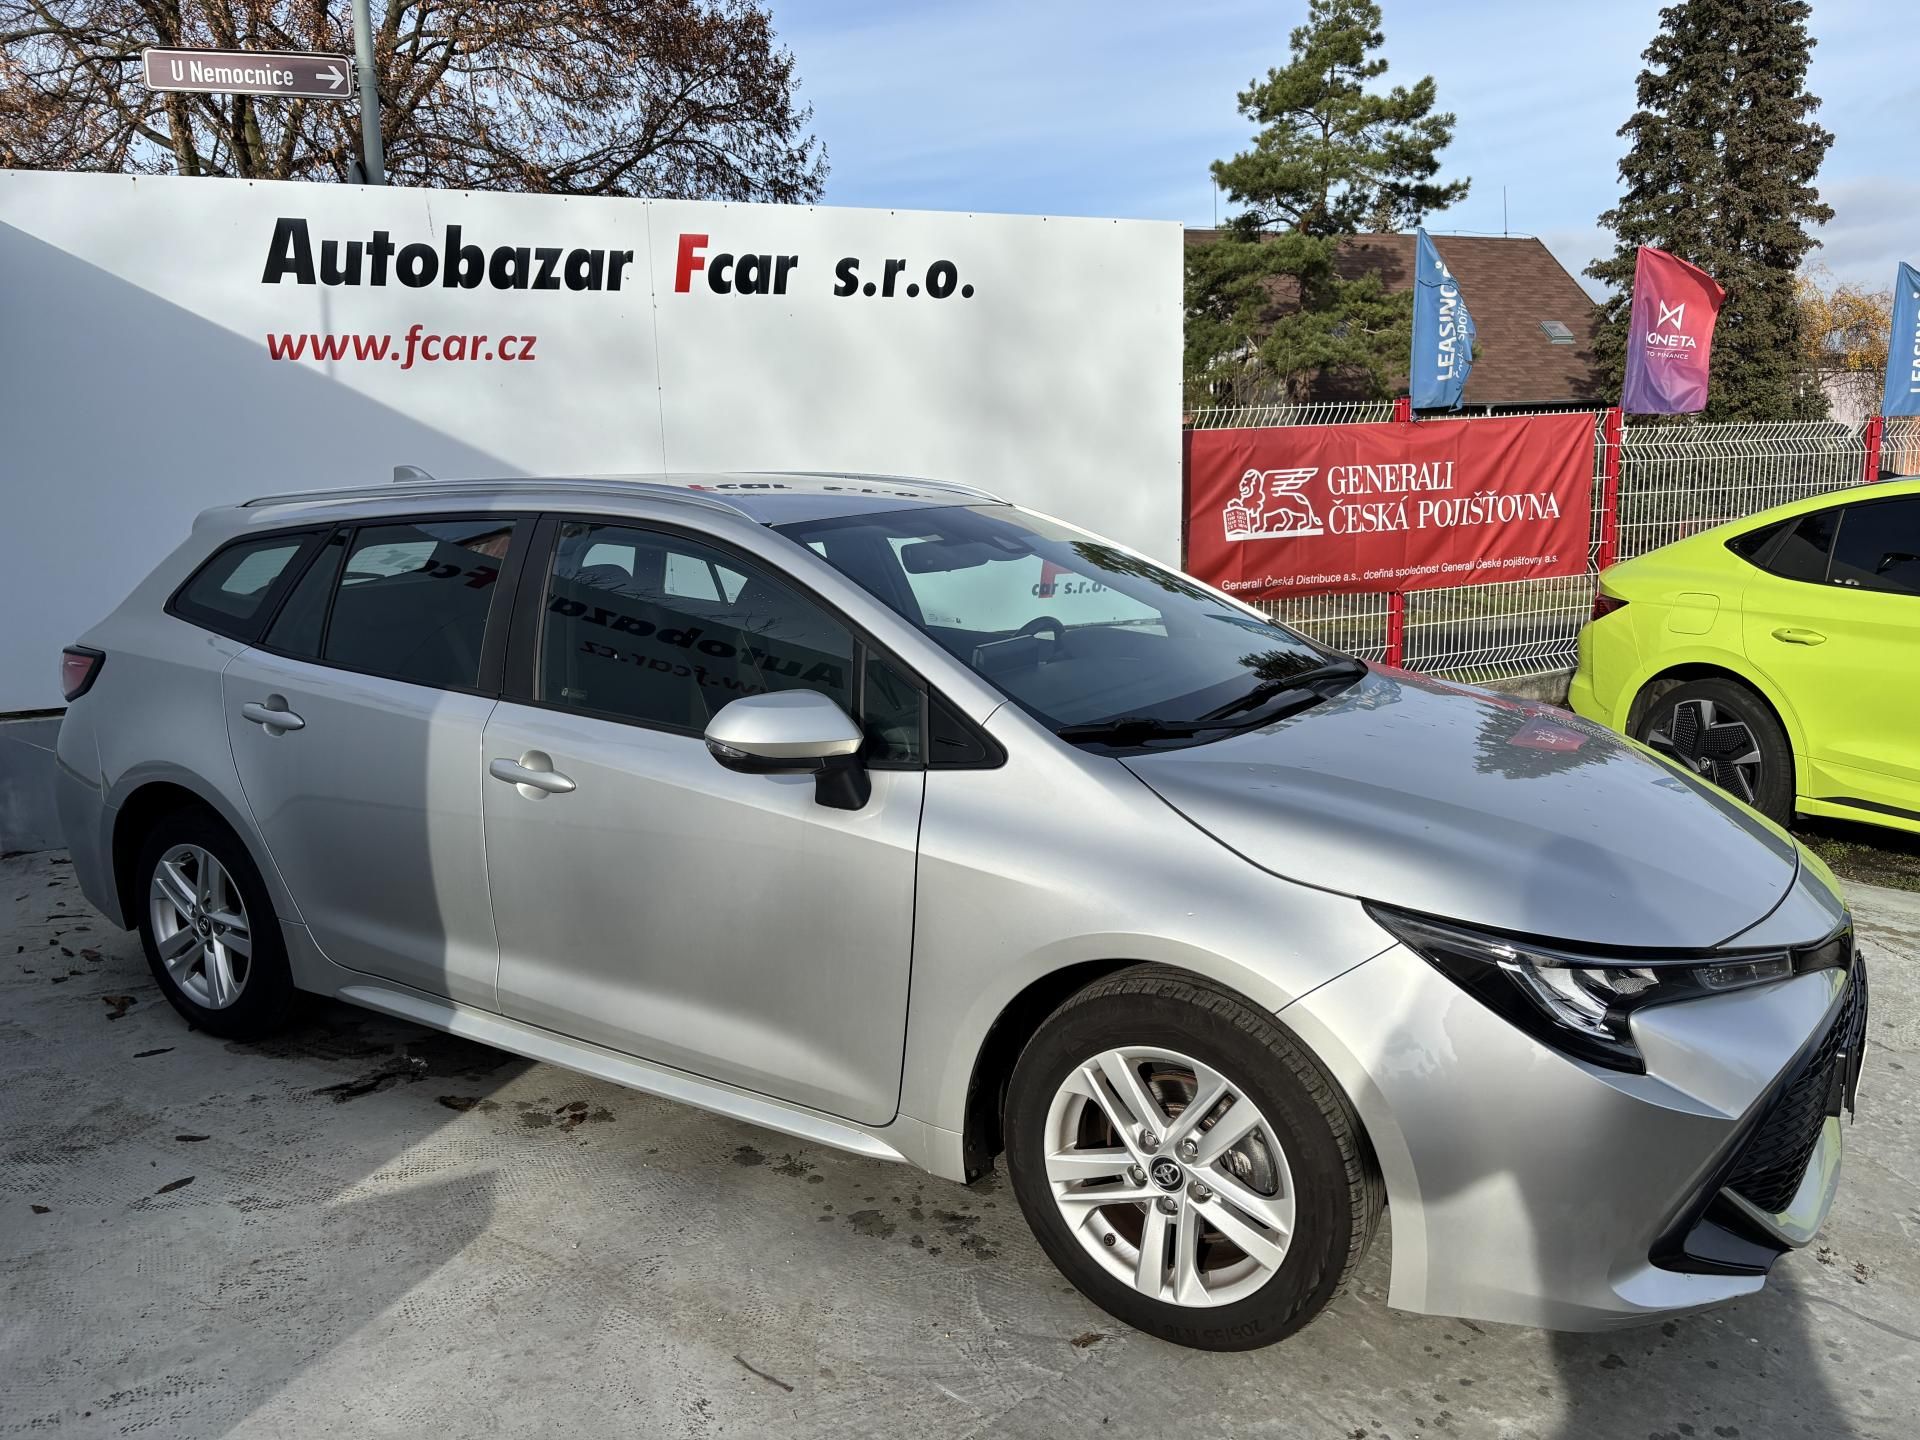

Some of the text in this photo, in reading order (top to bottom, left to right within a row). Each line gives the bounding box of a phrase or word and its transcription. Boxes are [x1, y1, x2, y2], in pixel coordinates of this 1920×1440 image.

[171, 60, 294, 86] U Nemocnice
[261, 217, 975, 299] Autobazar Fcar s.r.o.
[266, 324, 537, 370] www.fcar.cz
[1646, 331, 1697, 349] ONETA
[1657, 352, 1689, 360] FINANCE
[1326, 461, 1455, 496] GENERALI
[1328, 490, 1561, 535] ČESKÁ POJIŠŤOVNA
[1221, 554, 1558, 591] Generali Česká Distribuce a.s., dceřiná společnost Generali České pojišťovny a.s.
